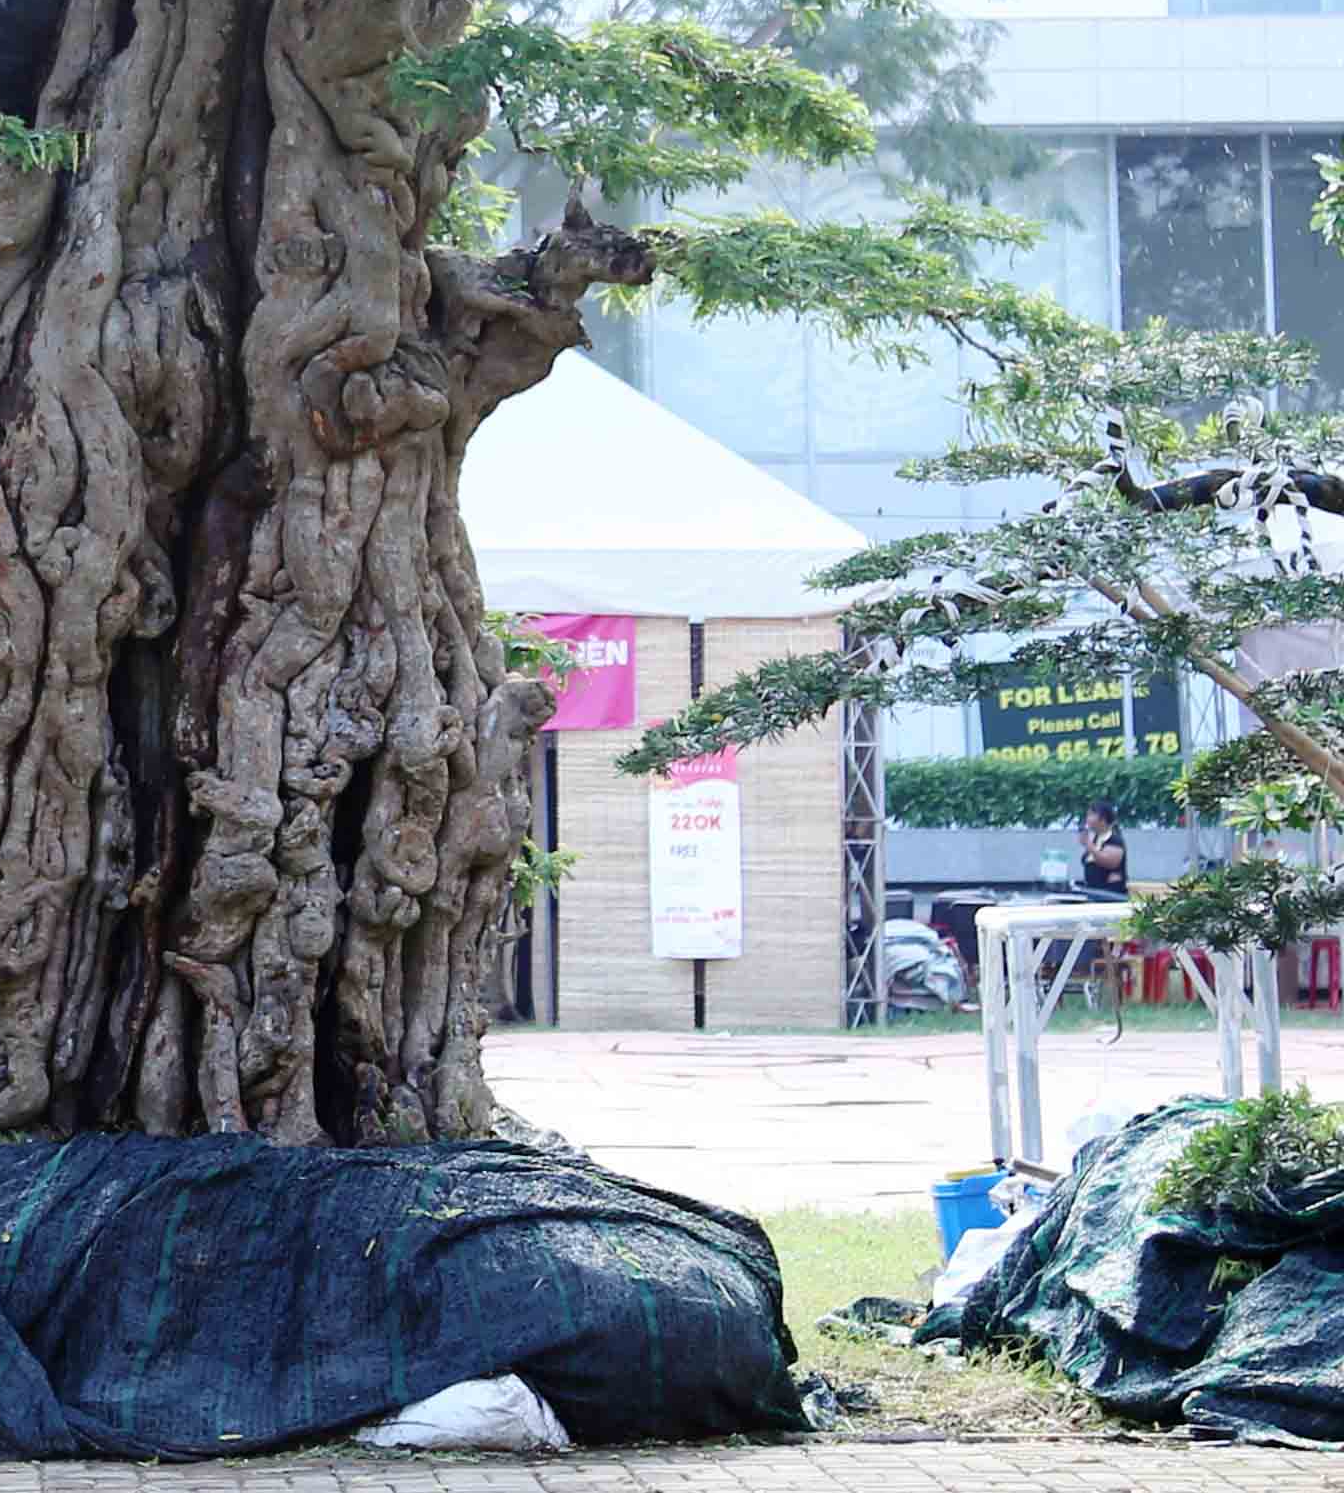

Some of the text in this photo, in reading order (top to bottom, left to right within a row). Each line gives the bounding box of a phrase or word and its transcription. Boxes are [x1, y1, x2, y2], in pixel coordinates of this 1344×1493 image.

[999, 683, 1052, 710] FOR
[1027, 710, 1120, 734] Please Call
[1145, 730, 1179, 755] 78
[670, 813, 723, 830] 220K
